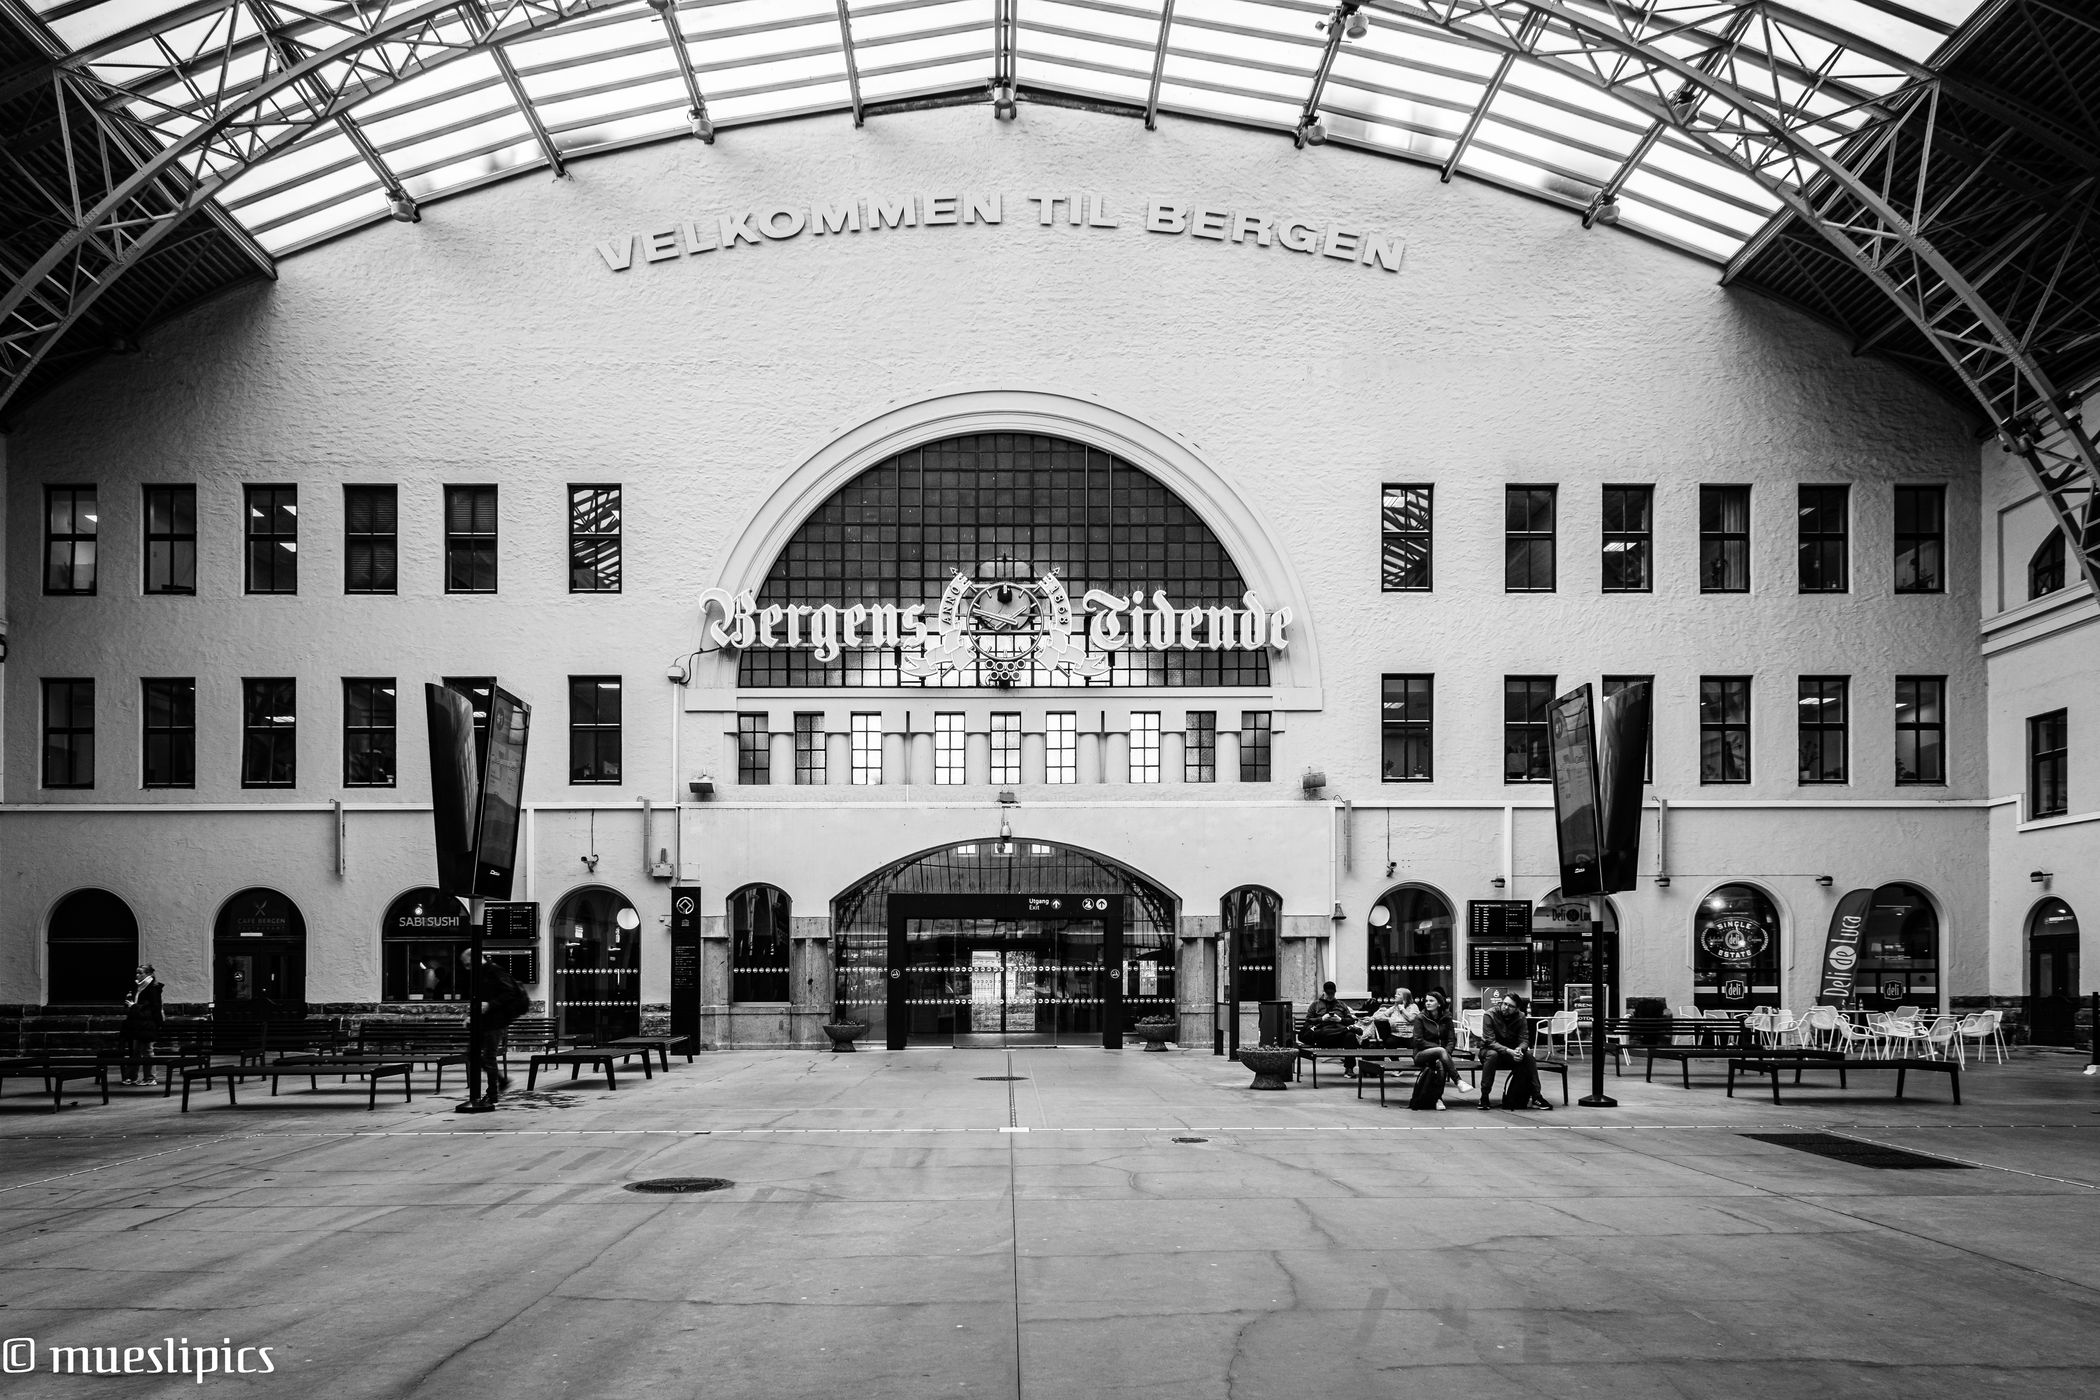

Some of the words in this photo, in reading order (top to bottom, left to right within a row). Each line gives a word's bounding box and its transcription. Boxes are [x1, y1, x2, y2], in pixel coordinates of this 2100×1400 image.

[597, 192, 1003, 272] VELKOMMEN
[1028, 193, 1119, 229] TIL
[1146, 200, 1406, 273] BERGEN
[942, 586, 961, 626] ANNO
[1050, 586, 1069, 625] 1868
[700, 587, 927, 662] Bergens
[1082, 590, 1293, 650] Tidende
[1552, 908, 1566, 921] Deli
[399, 917, 425, 927] SABI
[427, 917, 460, 927] SUSHI
[1717, 921, 1752, 930] SINGLE
[1830, 915, 1862, 944] Luca
[1718, 949, 1752, 958] ESTATE
[1728, 983, 1741, 996] deli
[1822, 972, 1852, 997] Deli
[1886, 983, 1900, 996] deli
